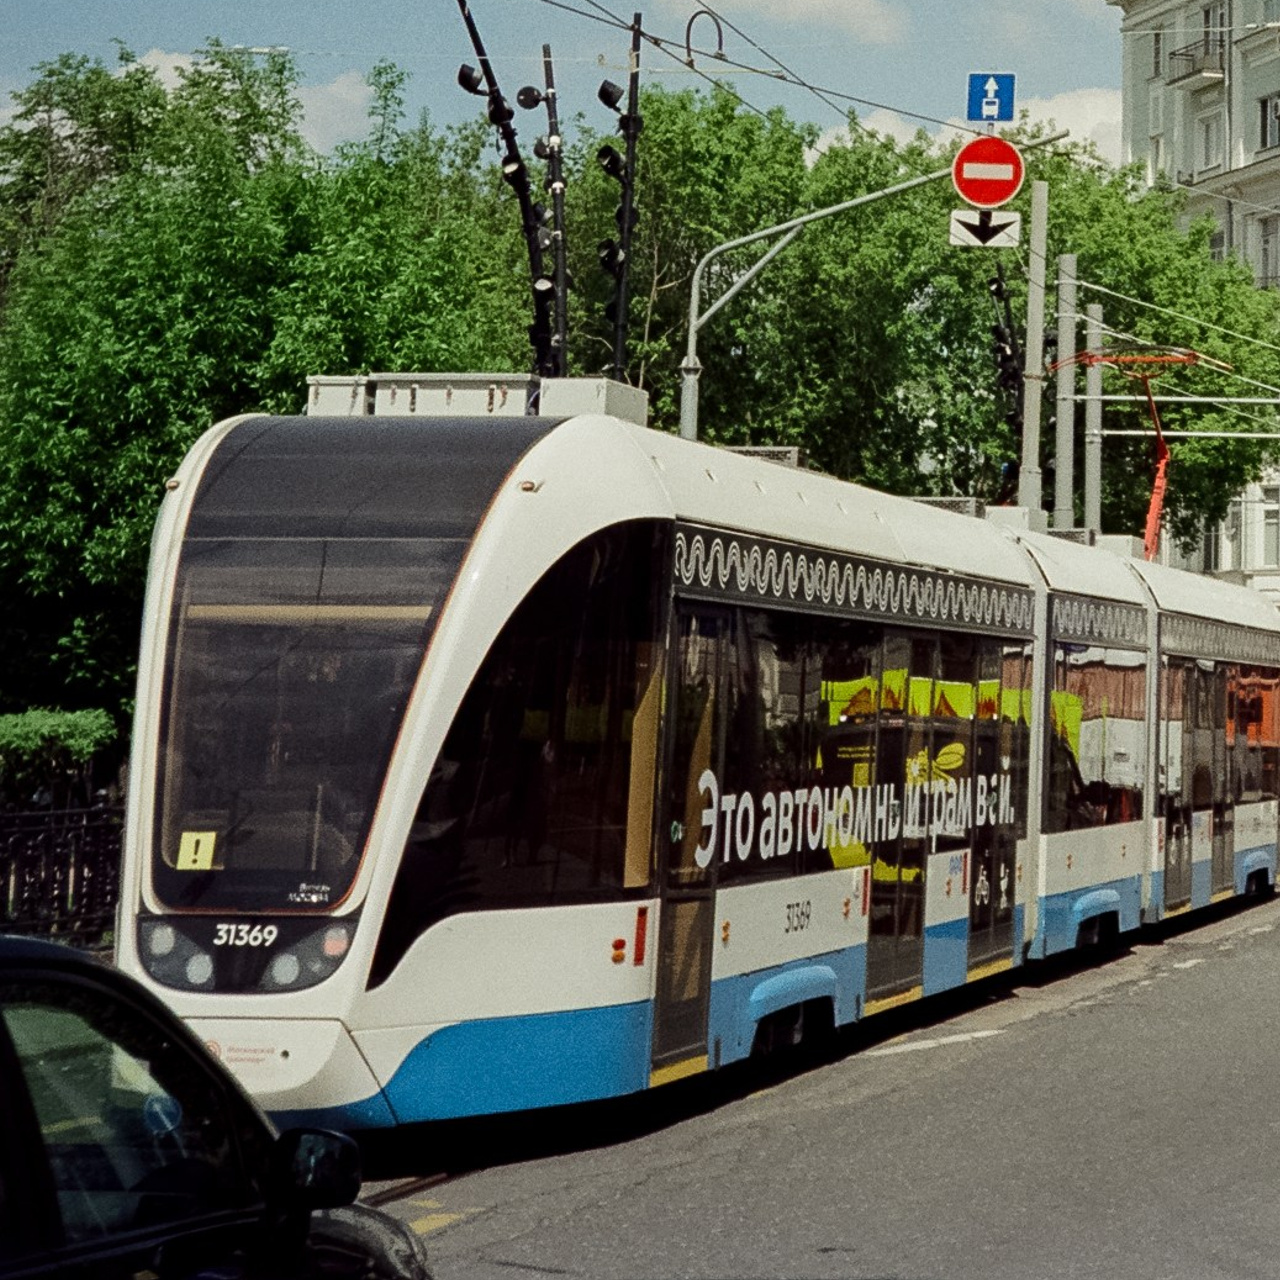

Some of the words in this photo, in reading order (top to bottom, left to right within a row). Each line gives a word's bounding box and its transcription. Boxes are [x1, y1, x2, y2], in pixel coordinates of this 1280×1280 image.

[694, 768, 755, 869] Это
[785, 900, 812, 934] 31369
[213, 923, 279, 947] 31369
